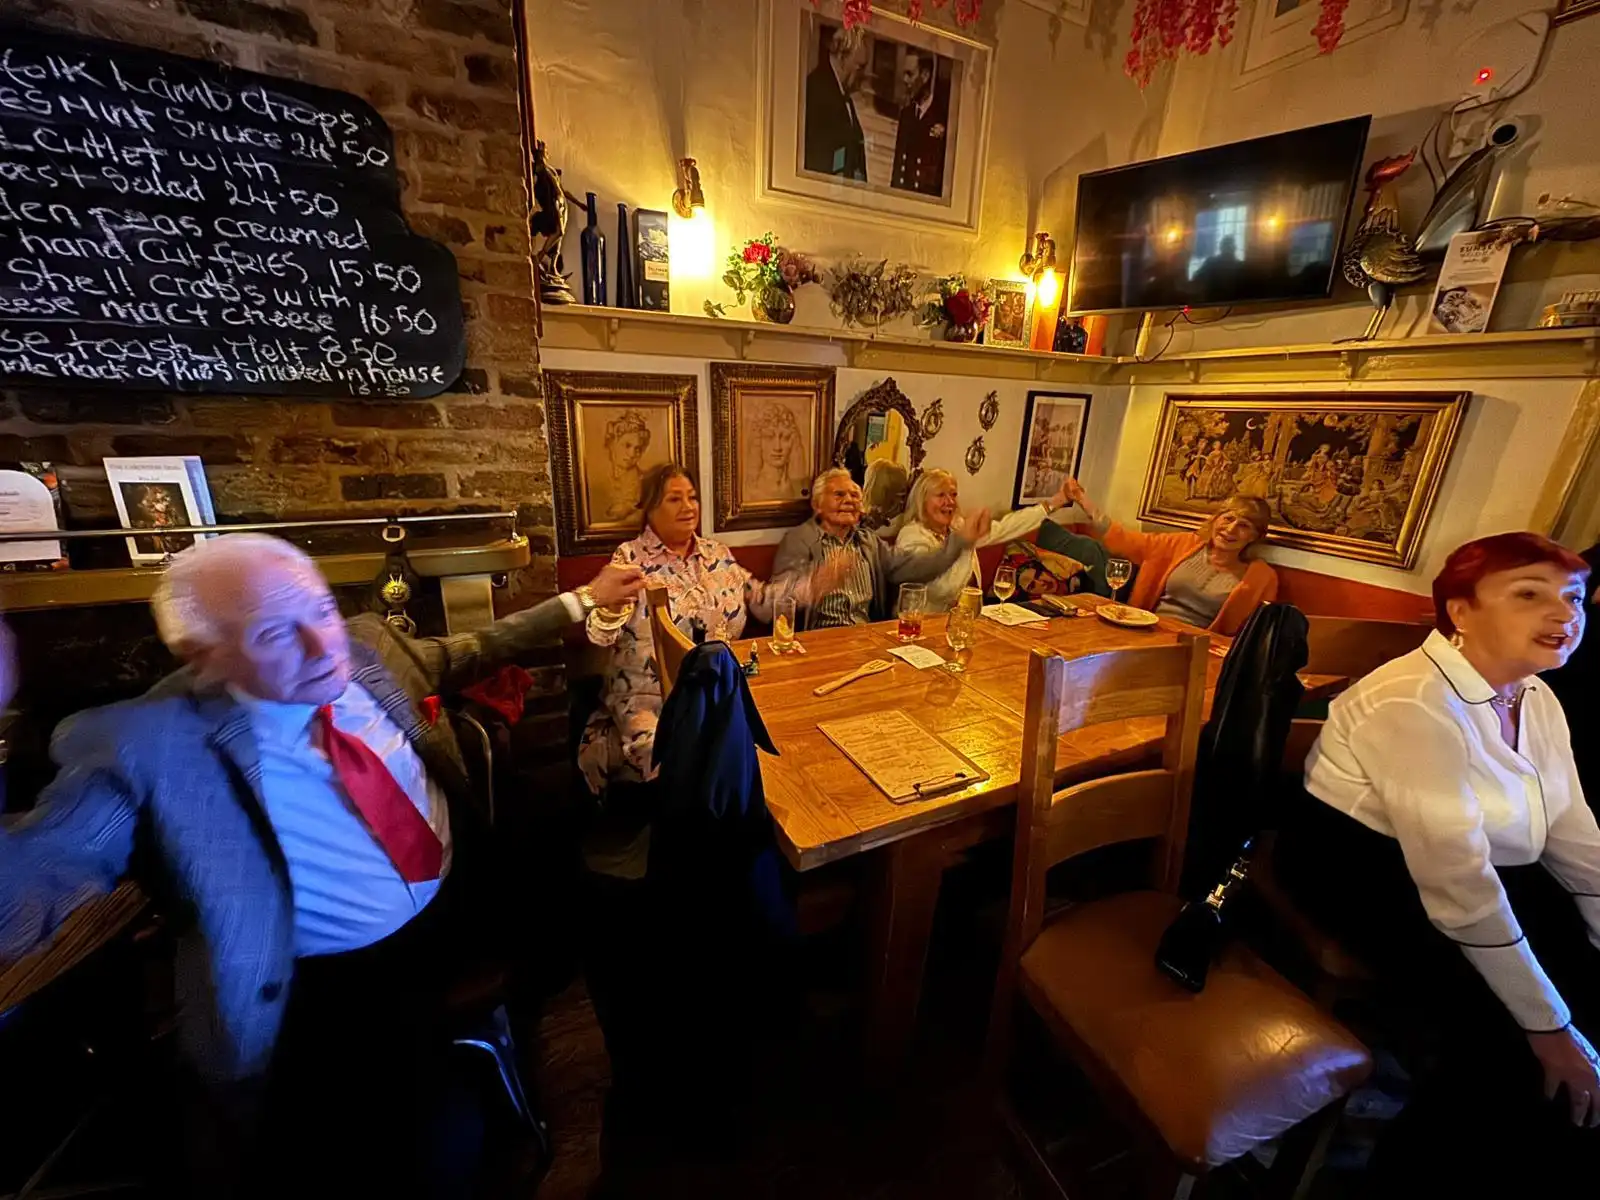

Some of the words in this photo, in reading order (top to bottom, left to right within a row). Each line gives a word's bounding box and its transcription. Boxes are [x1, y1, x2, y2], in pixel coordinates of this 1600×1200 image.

[109, 58, 232, 112] Lamb
[179, 145, 281, 185] with
[7, 257, 136, 297] Shell
